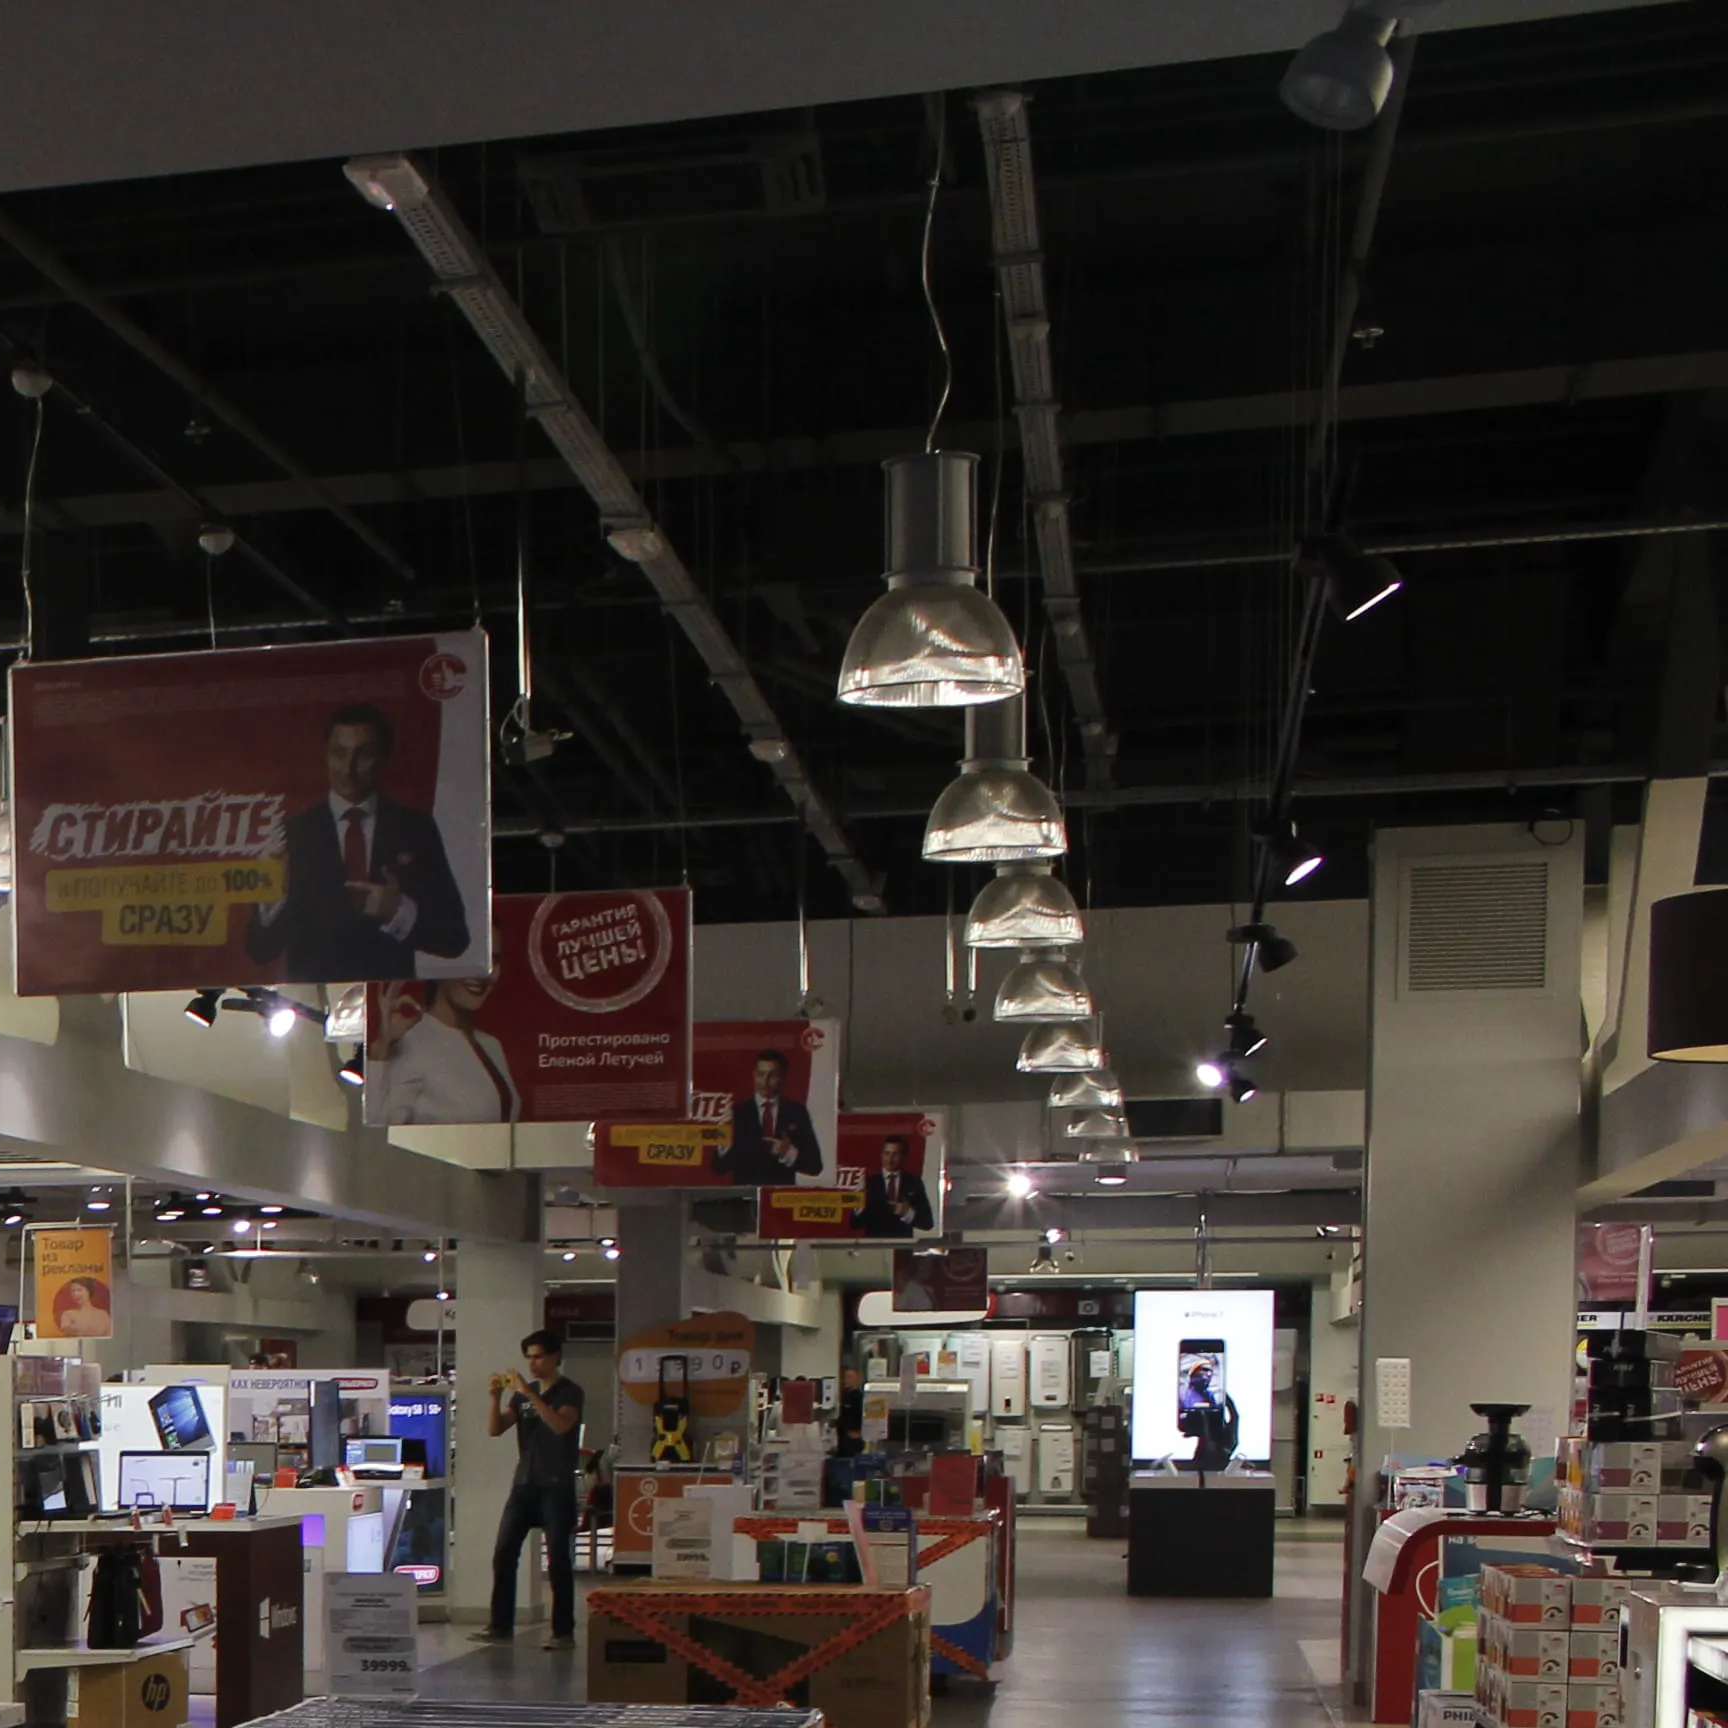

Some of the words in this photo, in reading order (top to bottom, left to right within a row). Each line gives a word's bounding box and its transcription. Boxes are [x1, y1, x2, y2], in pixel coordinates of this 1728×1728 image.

[46, 793, 274, 856] СТИРАЙТЕ
[221, 868, 273, 893] 100%
[119, 904, 214, 936] СРАЗУ
[551, 904, 639, 937] ГАРАНТИЯ
[557, 919, 643, 957] ЛУЧШЕЙ
[538, 1033, 671, 1050] Протестировано
[538, 1052, 595, 1068] Еленой
[599, 1051, 665, 1070] Летучей
[647, 1144, 696, 1162] СРАЗУ
[799, 1205, 837, 1219] СРАЗУ
[42, 1237, 85, 1252] Товар
[42, 1263, 104, 1277] рекламы
